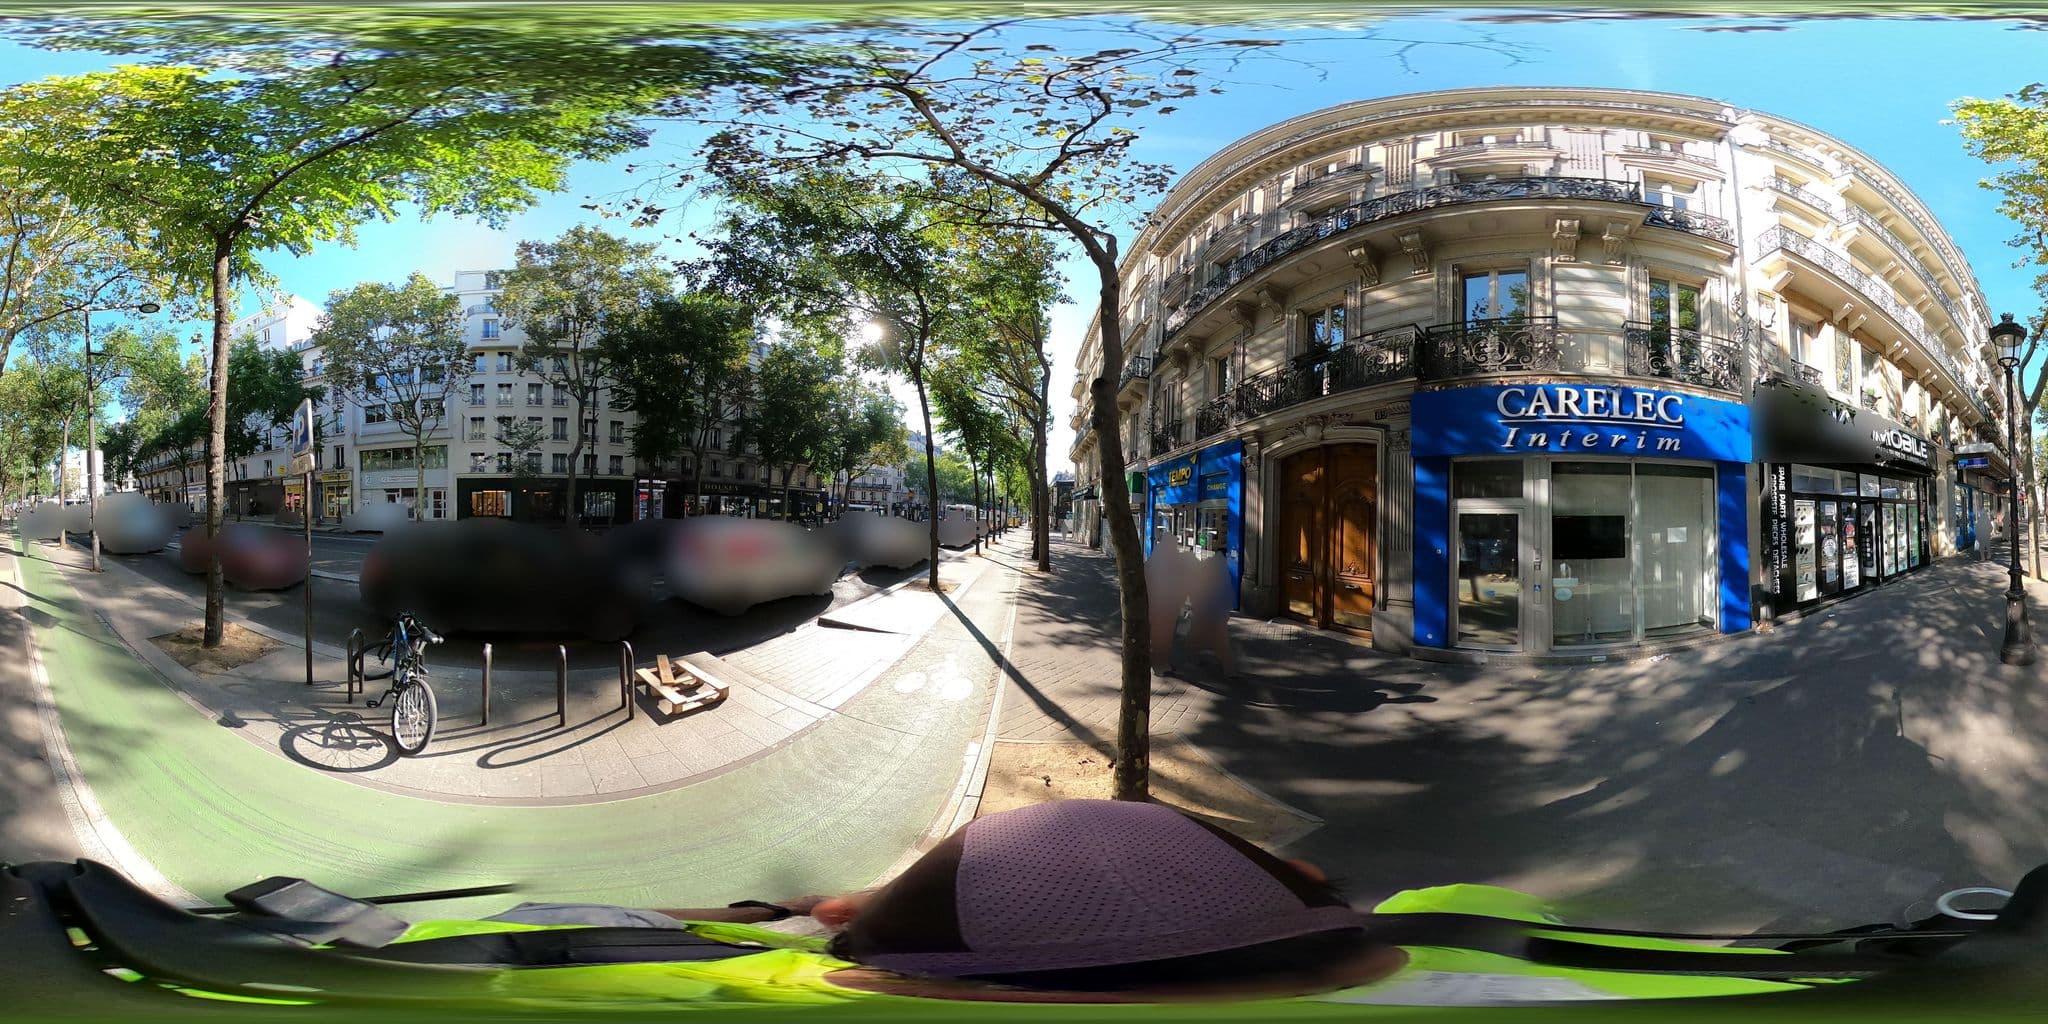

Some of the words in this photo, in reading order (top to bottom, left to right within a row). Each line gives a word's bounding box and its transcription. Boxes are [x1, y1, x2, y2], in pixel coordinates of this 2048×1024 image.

[1497, 386, 1684, 424] CARELEC
[1501, 427, 1681, 451] Interim
[1169, 466, 1191, 482] TEMPO
[1780, 522, 1788, 569] WHOLESALE
